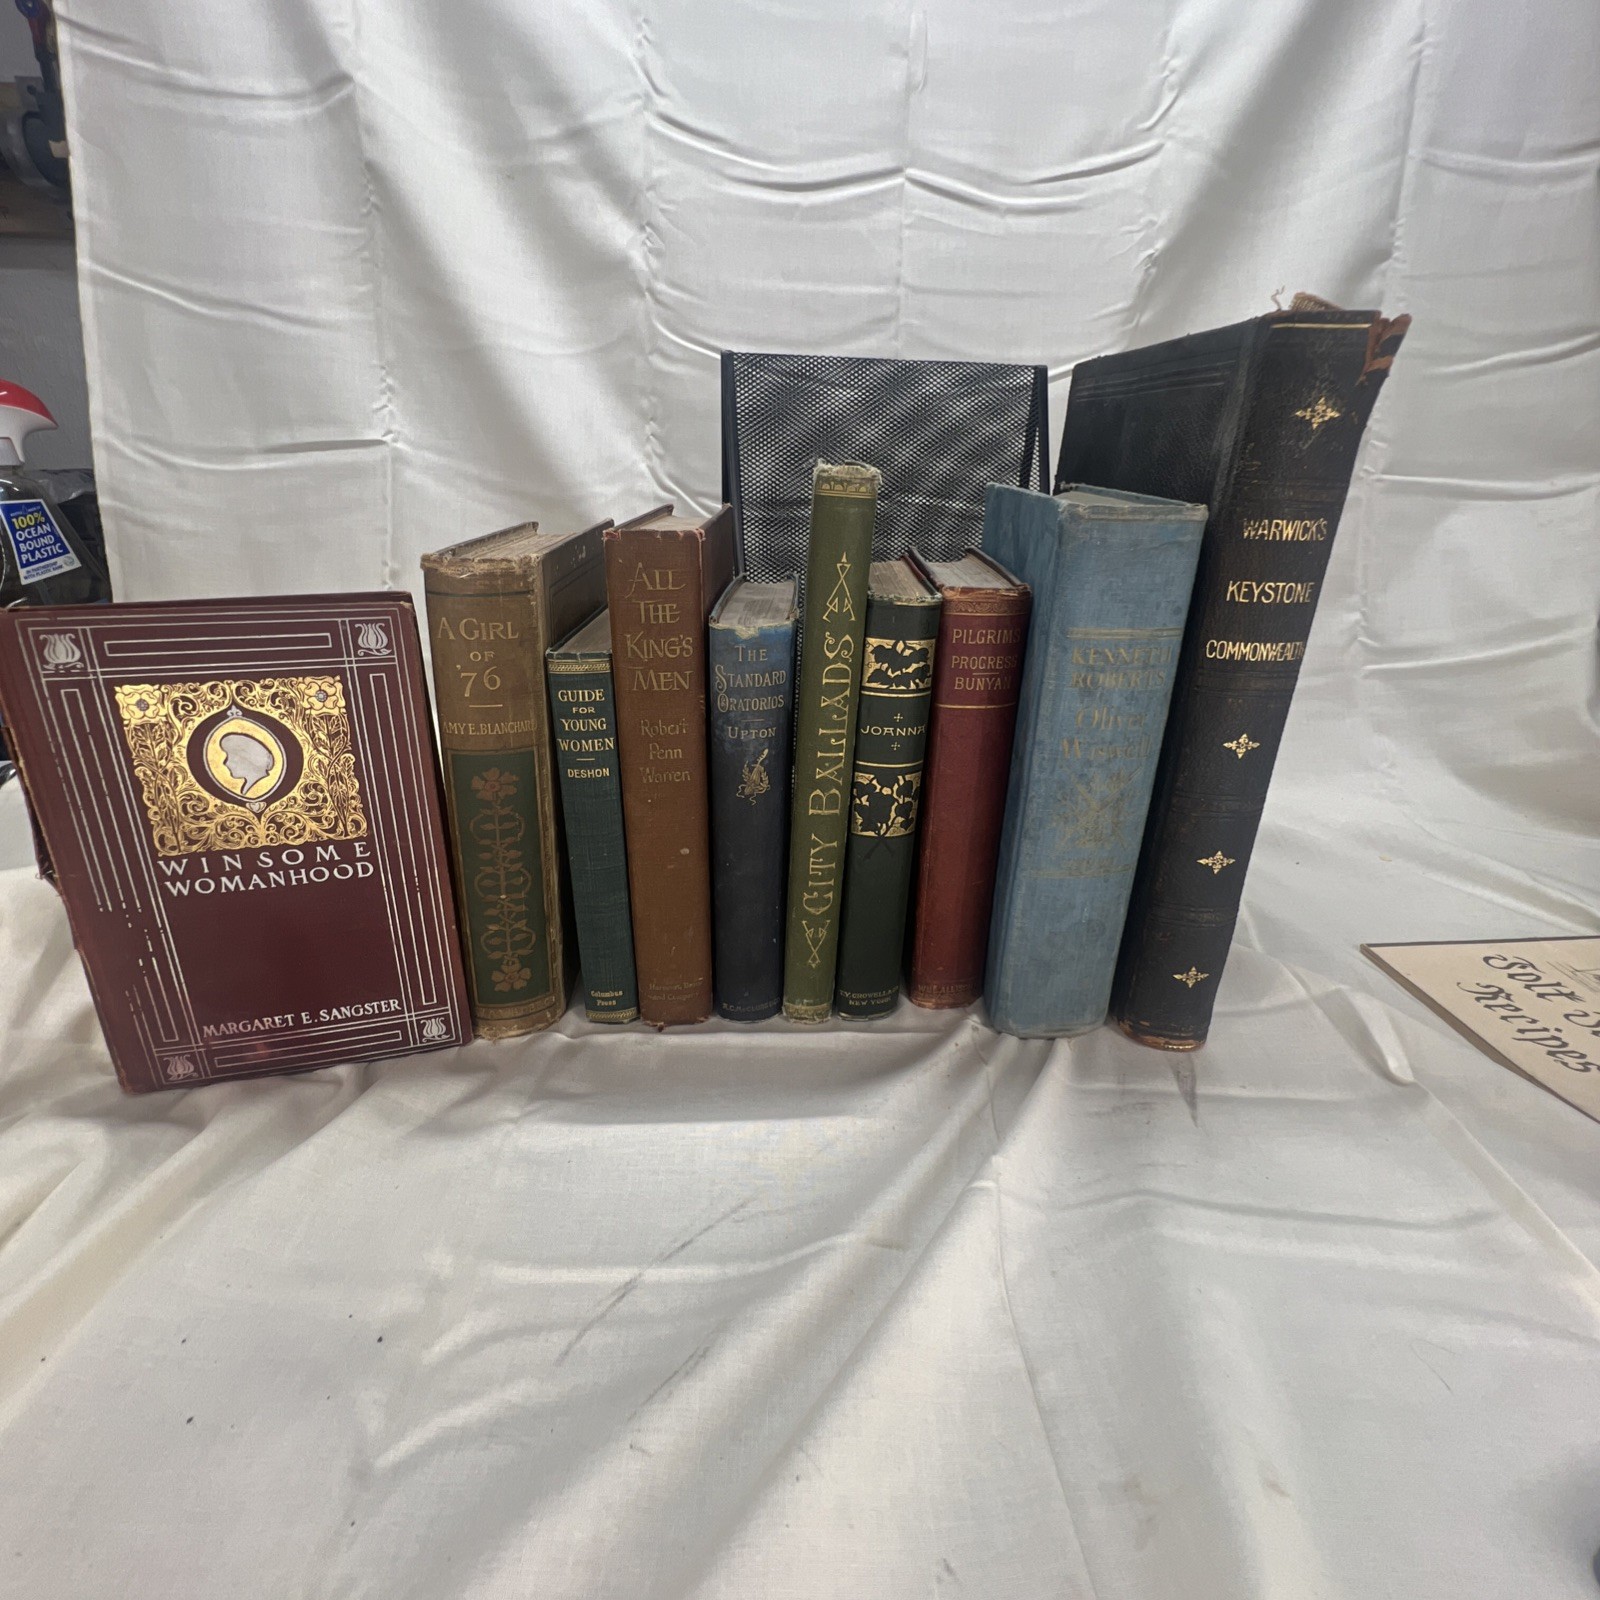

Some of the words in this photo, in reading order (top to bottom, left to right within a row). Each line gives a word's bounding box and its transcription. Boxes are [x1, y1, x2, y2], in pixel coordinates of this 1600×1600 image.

[11, 511, 46, 530] 100%
[1243, 518, 1327, 541] WARWICK'S
[15, 523, 52, 541] OCEAN
[18, 535, 55, 552] BOUND
[20, 543, 64, 564] PLASTIC
[625, 562, 687, 599] ALL
[1226, 580, 1315, 604] KEYSTONE
[629, 600, 682, 625] THE
[437, 617, 456, 641] A
[459, 617, 520, 641] GIRL
[952, 628, 1021, 645] PILGRIMS
[624, 630, 694, 662] KING'S
[735, 644, 768, 662] THE
[469, 651, 496, 662] OF
[951, 655, 1018, 670] PROGRESS
[455, 664, 501, 698] '76
[631, 668, 695, 692] MEN
[715, 664, 787, 694] STANDARD
[954, 676, 1012, 691] BUNYAN
[558, 688, 605, 703] GUIDE
[717, 692, 785, 713] ORATORIOS
[572, 706, 596, 714] FOR
[442, 720, 466, 735] AMY
[560, 717, 607, 732] YOUNG
[640, 717, 689, 738] Robert
[727, 726, 777, 740] UPTON
[808, 631, 855, 817] BALLADS
[860, 725, 926, 737] JOANNA
[557, 737, 615, 752] WOMEN
[648, 742, 684, 761] Penn
[567, 767, 610, 779] DESHON
[157, 841, 371, 877] WINSOME
[164, 861, 374, 897] WOMANHOOD
[801, 834, 838, 915] CITY
[202, 1013, 295, 1038] MARGARET
[319, 999, 402, 1022] SANGSTER
